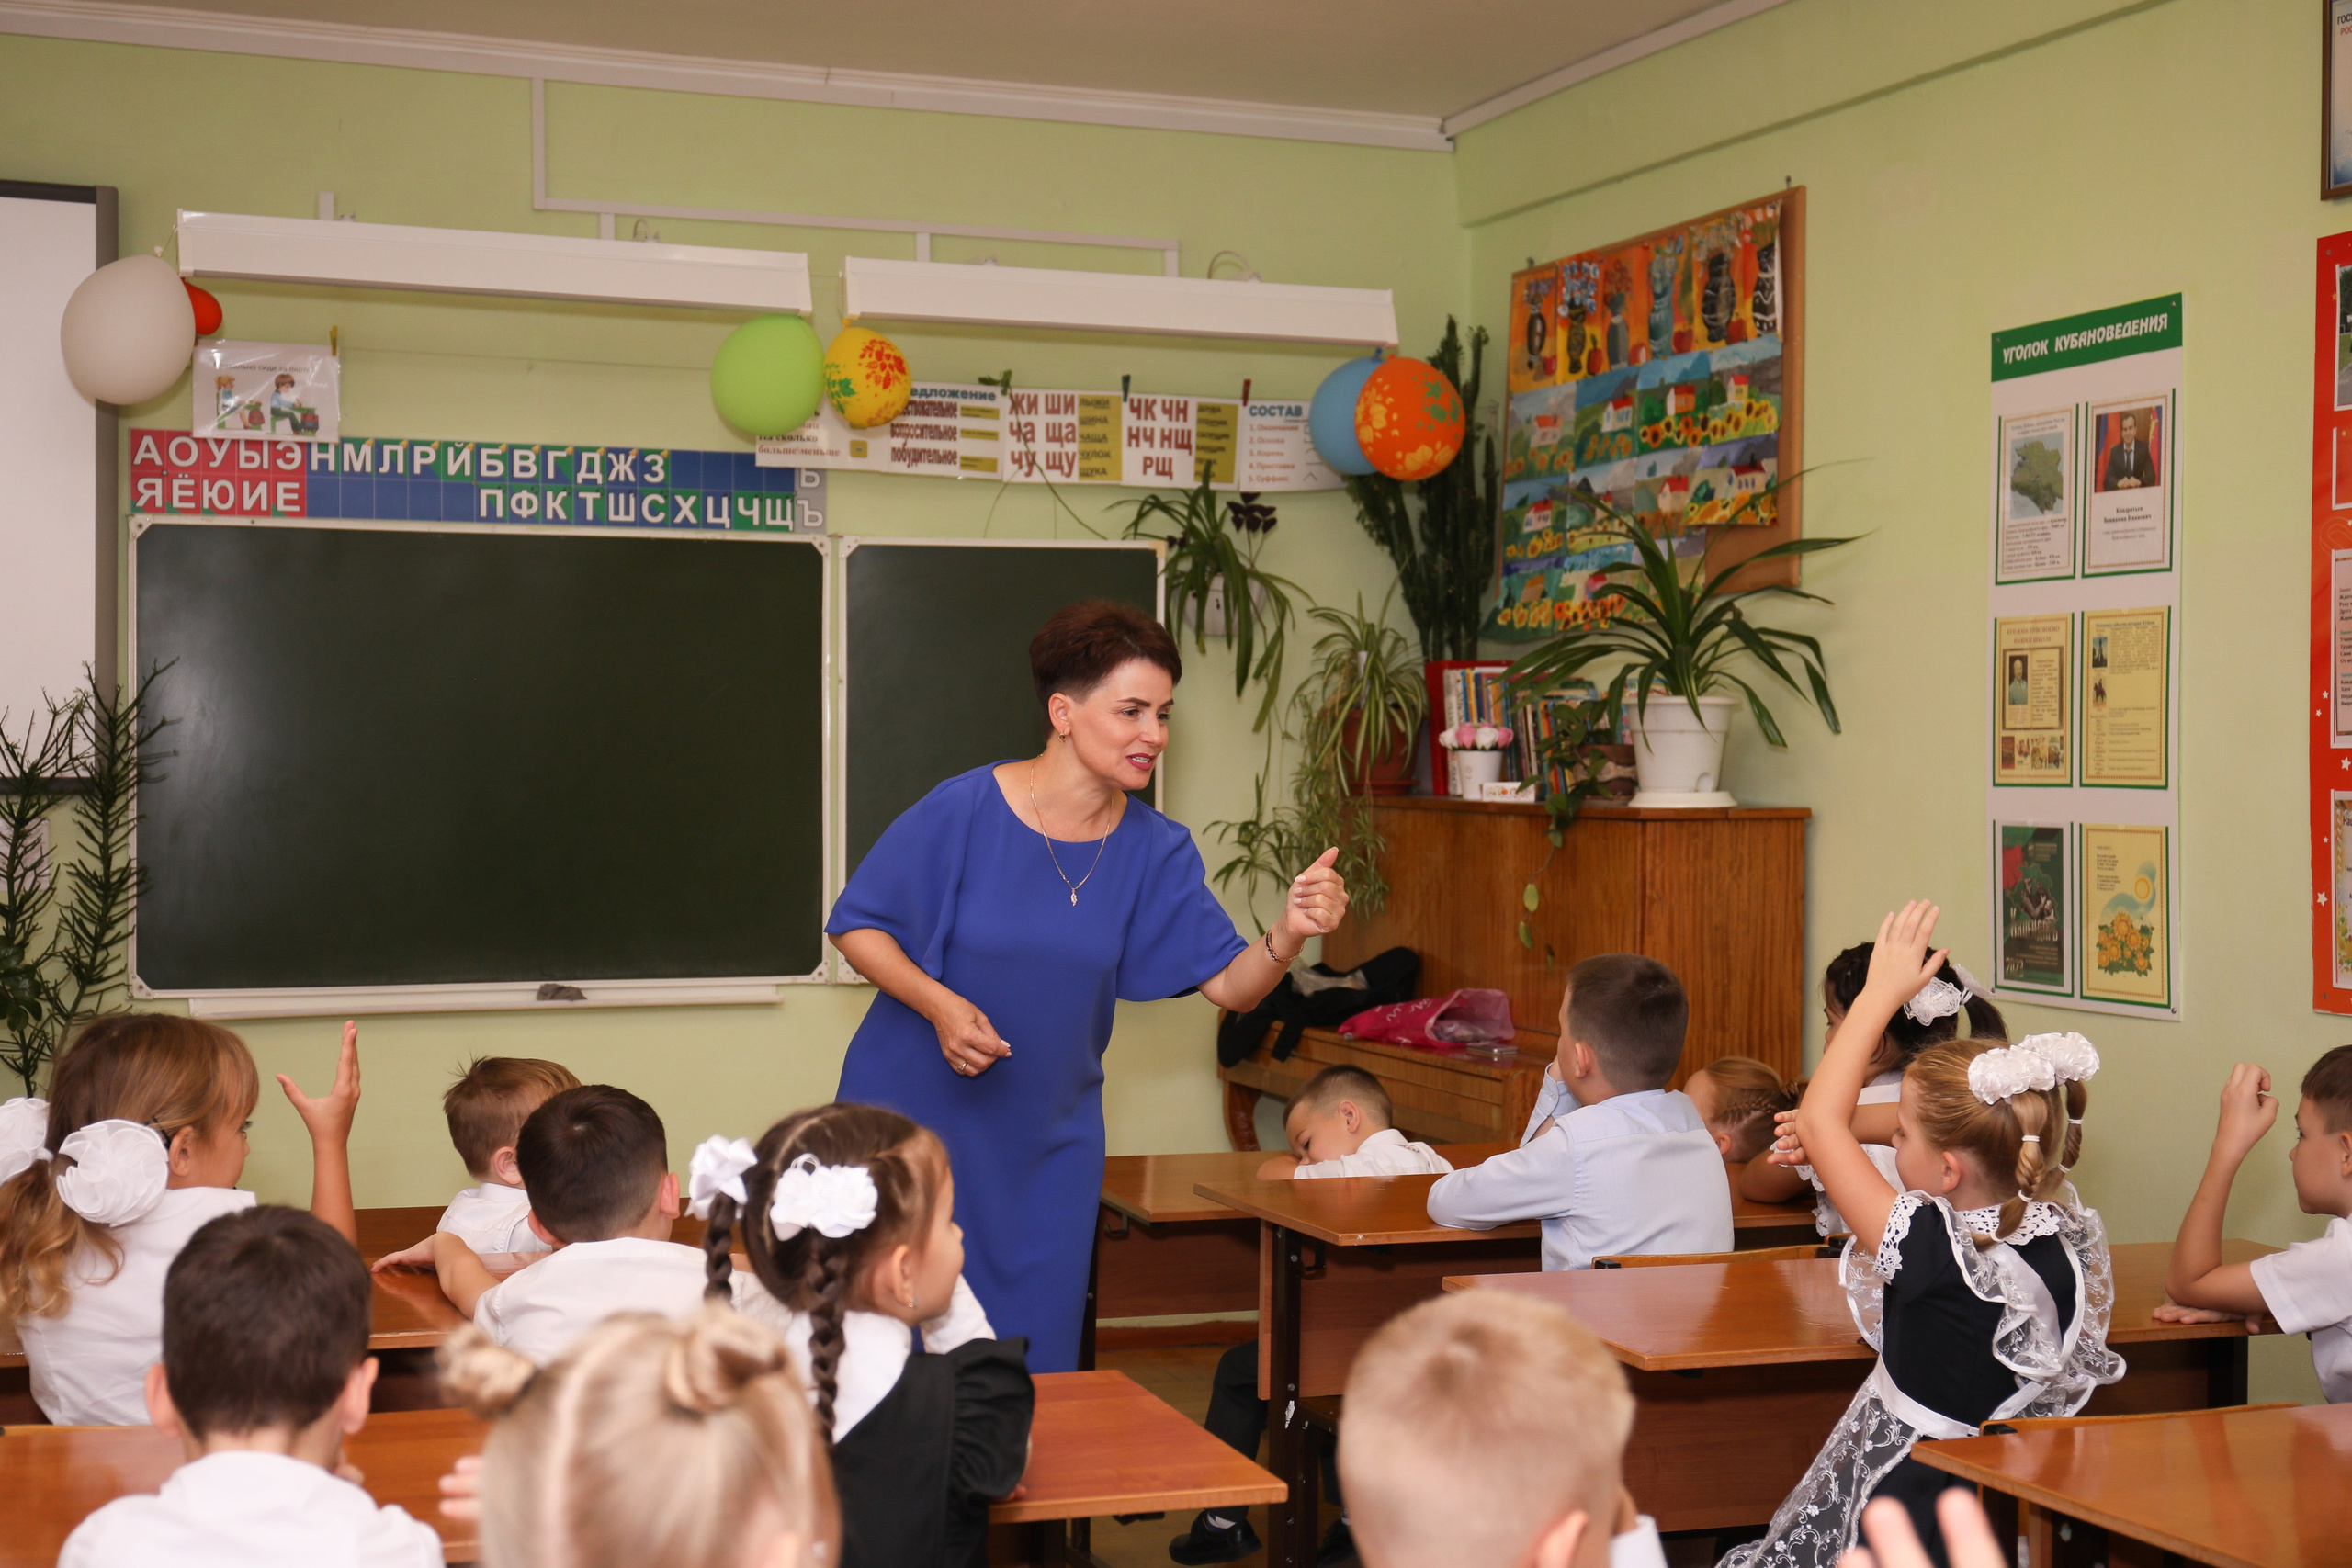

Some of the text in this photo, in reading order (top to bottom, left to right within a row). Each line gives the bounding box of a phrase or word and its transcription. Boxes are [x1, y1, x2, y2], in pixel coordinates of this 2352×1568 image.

[2003, 312, 2168, 364] УГОЛОК КУБАНОВЕДЕНИЯ
[910, 387, 997, 401] едложение
[1079, 398, 1110, 407] ЛЫЖИ
[1129, 397, 1188, 423] ЧК ЧН
[1249, 404, 1303, 417] СОСТАВ
[1079, 415, 1108, 424] ШИНА
[889, 423, 957, 441] вопросительное
[1079, 433, 1107, 442] ЧАЩА
[1127, 426, 1192, 456] НЧ НЩ
[890, 442, 957, 468] побудительное
[1079, 450, 1111, 458] ЧУЛОК
[1079, 468, 1107, 477] ЩУКА
[1142, 456, 1173, 480] РЩ
